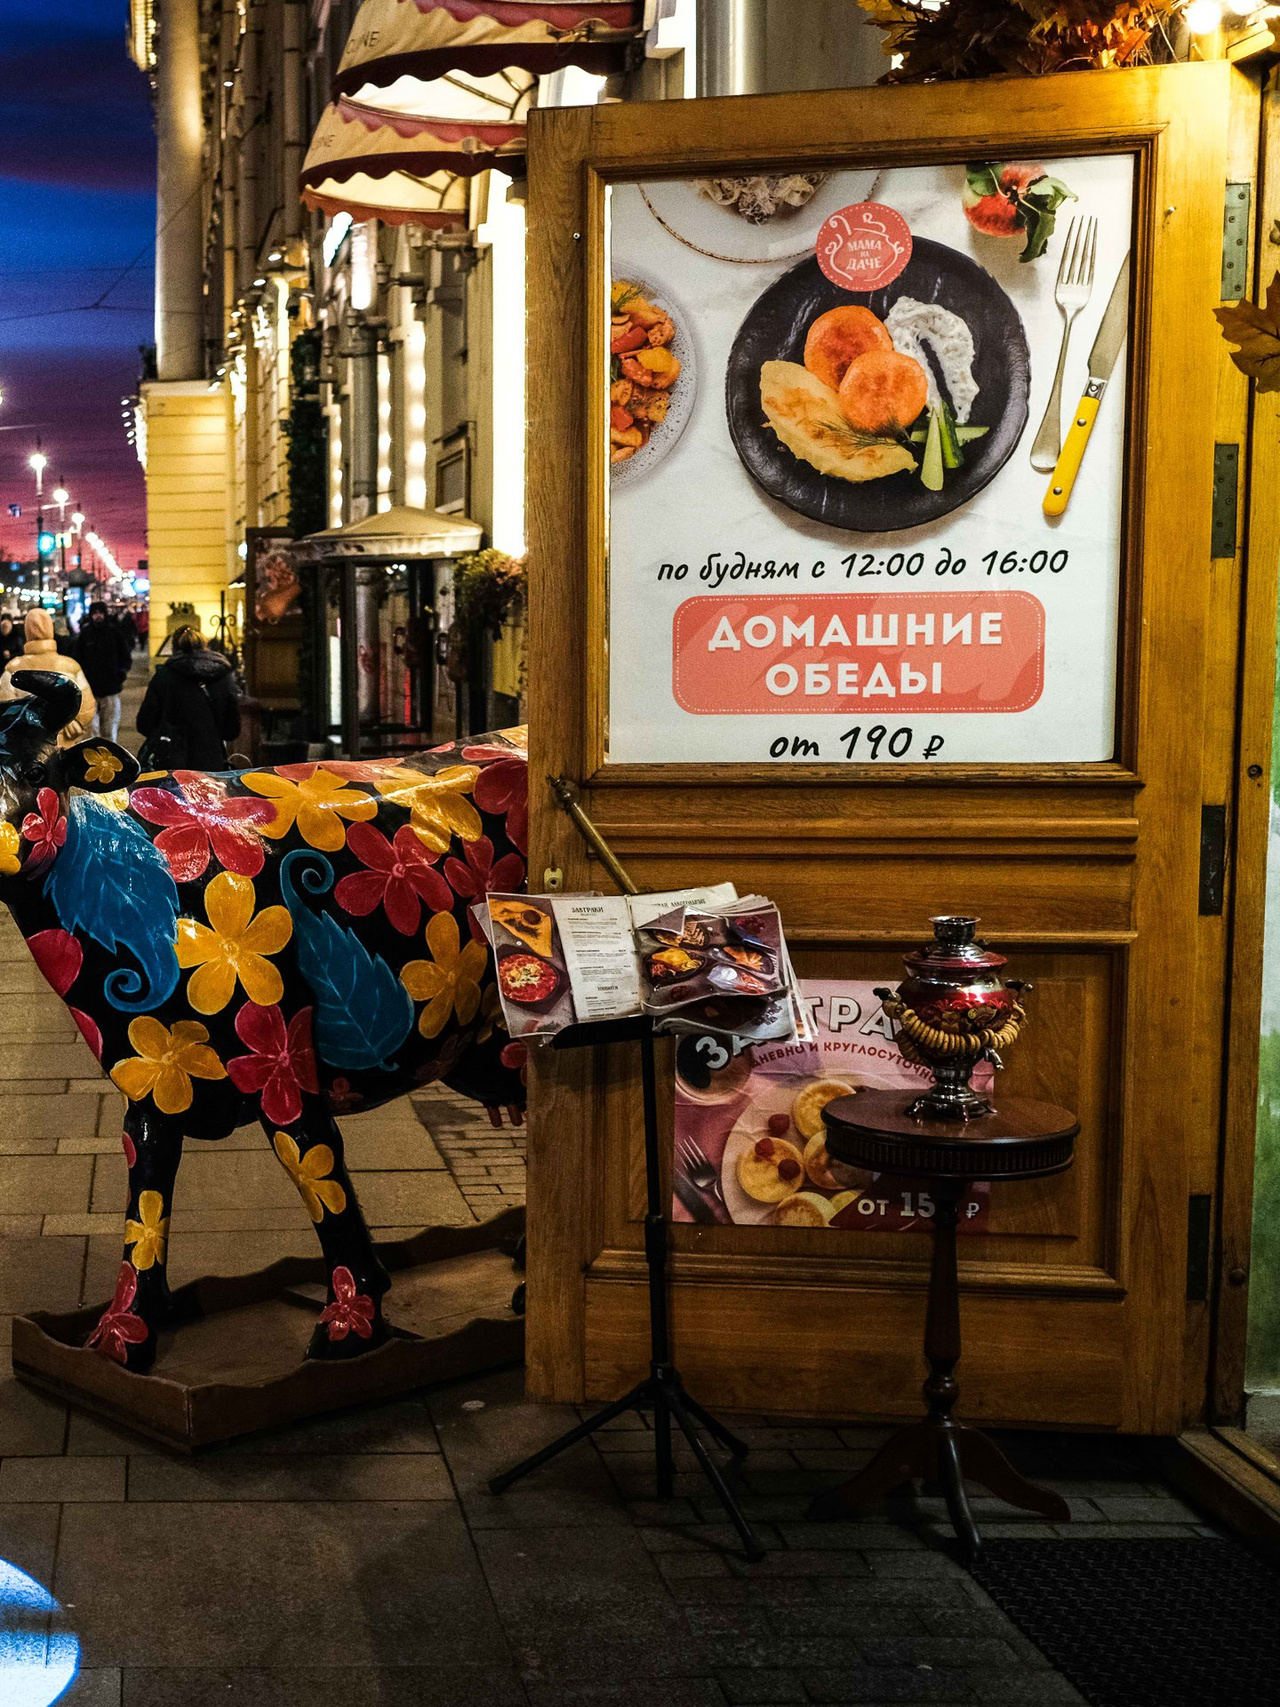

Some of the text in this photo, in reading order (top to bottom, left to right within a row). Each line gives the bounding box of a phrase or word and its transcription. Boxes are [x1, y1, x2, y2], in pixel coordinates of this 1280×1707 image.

[846, 256, 882, 271] ДАЧЕ
[847, 240, 882, 252] МАМА
[657, 547, 1069, 588] по будням с 12:00 до 16:00
[707, 612, 1003, 652] ДОМАШНИЕ
[765, 661, 942, 698] ОБЕДЫ
[769, 724, 945, 761] от 190 ₽
[753, 1042, 937, 1084] ДНЕВНО И КРУГЛОСУТОЧНО
[857, 1198, 890, 1216] ОТ
[900, 1191, 958, 1218] 15
